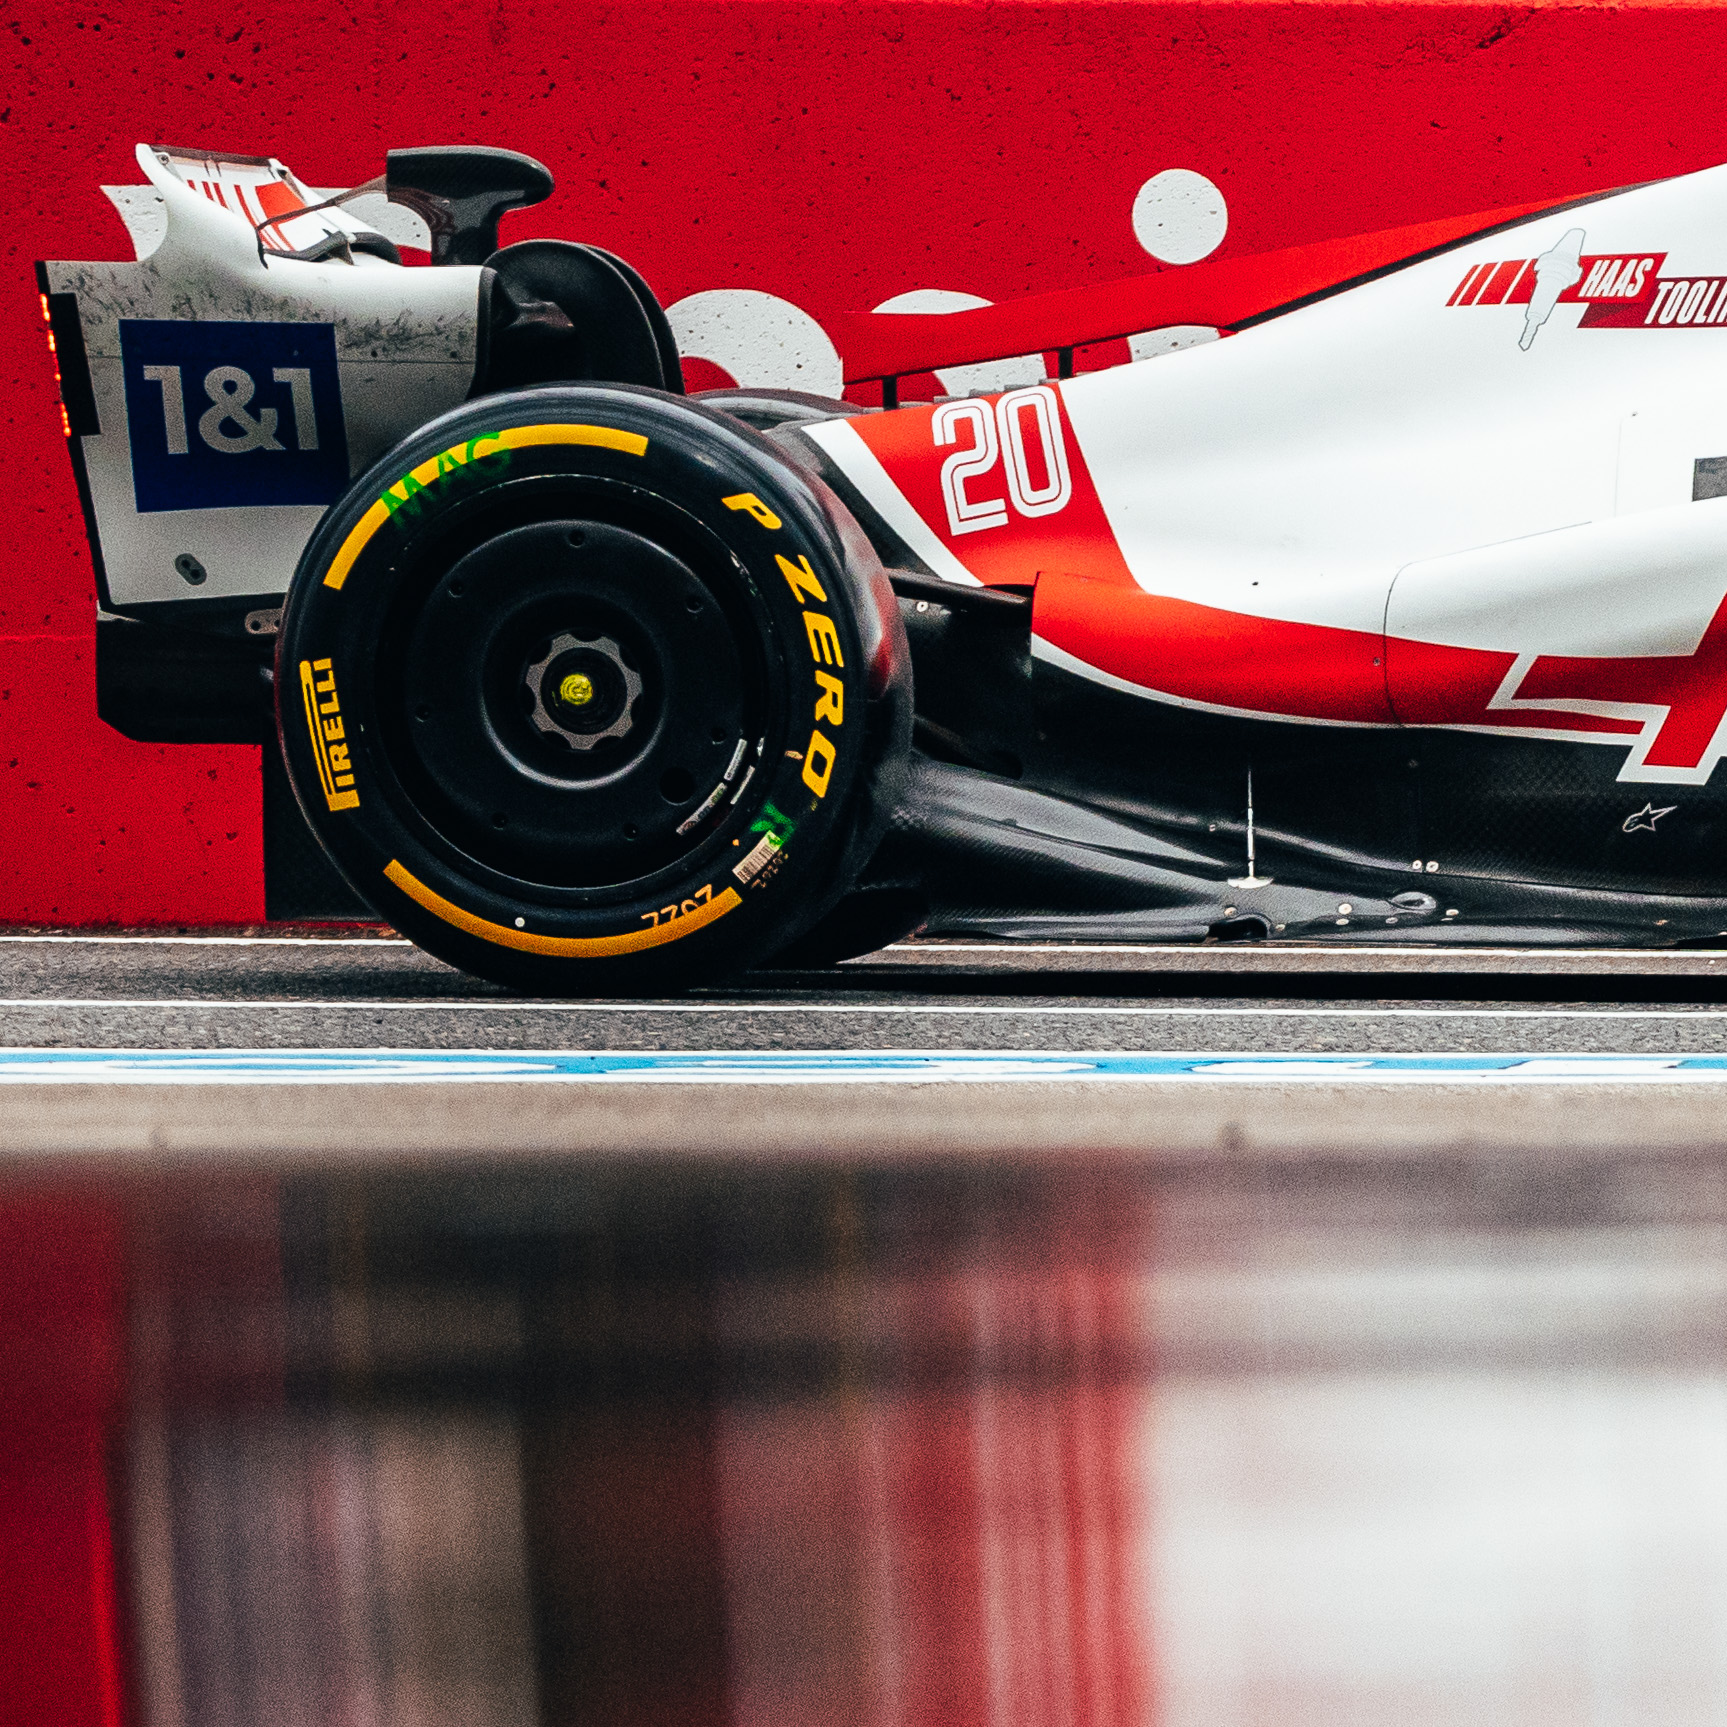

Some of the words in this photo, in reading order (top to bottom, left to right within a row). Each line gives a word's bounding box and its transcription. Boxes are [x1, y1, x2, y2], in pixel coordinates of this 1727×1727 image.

[1577, 258, 1654, 298] HAAS
[142, 364, 320, 455] 1&1
[930, 384, 1072, 536] 20
[379, 430, 512, 528] MAG
[720, 491, 784, 531] P
[774, 552, 845, 799] ZERO
[299, 657, 361, 812] PIRELLI
